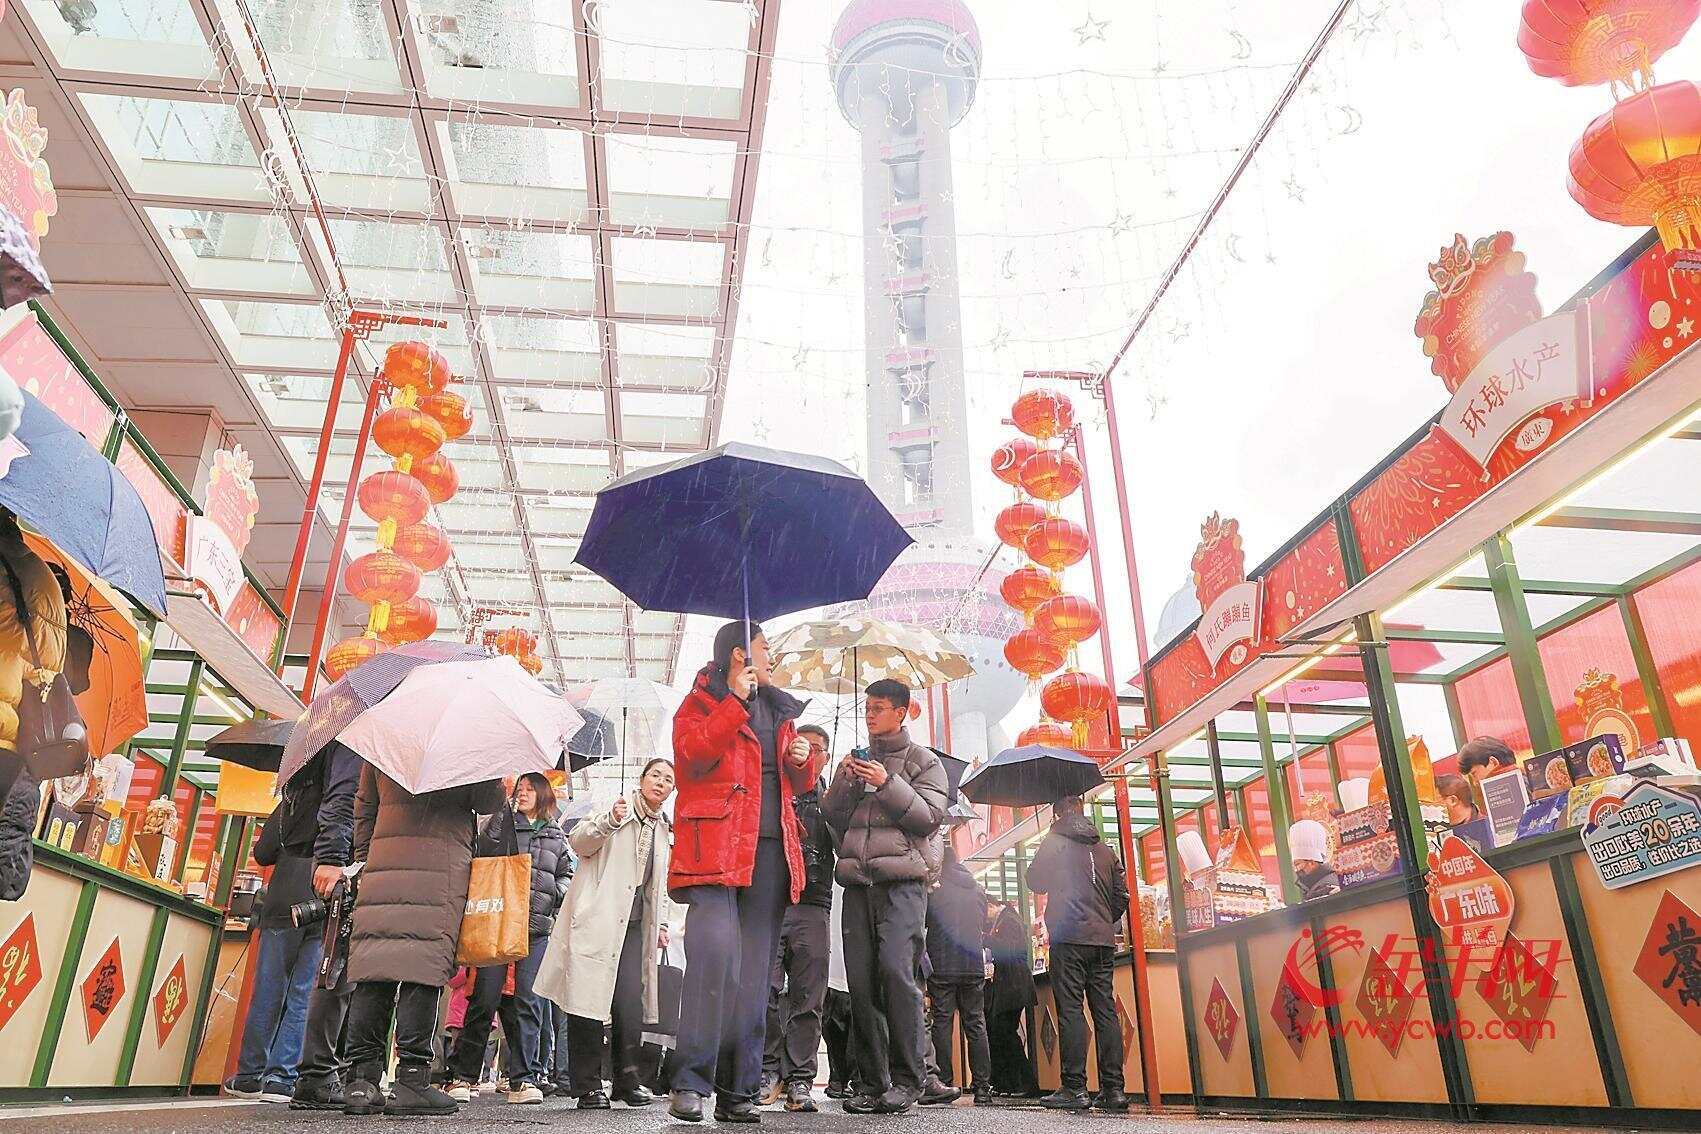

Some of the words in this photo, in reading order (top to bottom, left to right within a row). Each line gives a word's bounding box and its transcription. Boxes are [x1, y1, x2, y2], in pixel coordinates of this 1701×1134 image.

[1460, 342, 1560, 438] 环球水产
[1620, 799, 1662, 826] 环球水产
[1441, 855, 1476, 878] 中国年
[1440, 883, 1500, 922] 广东味
